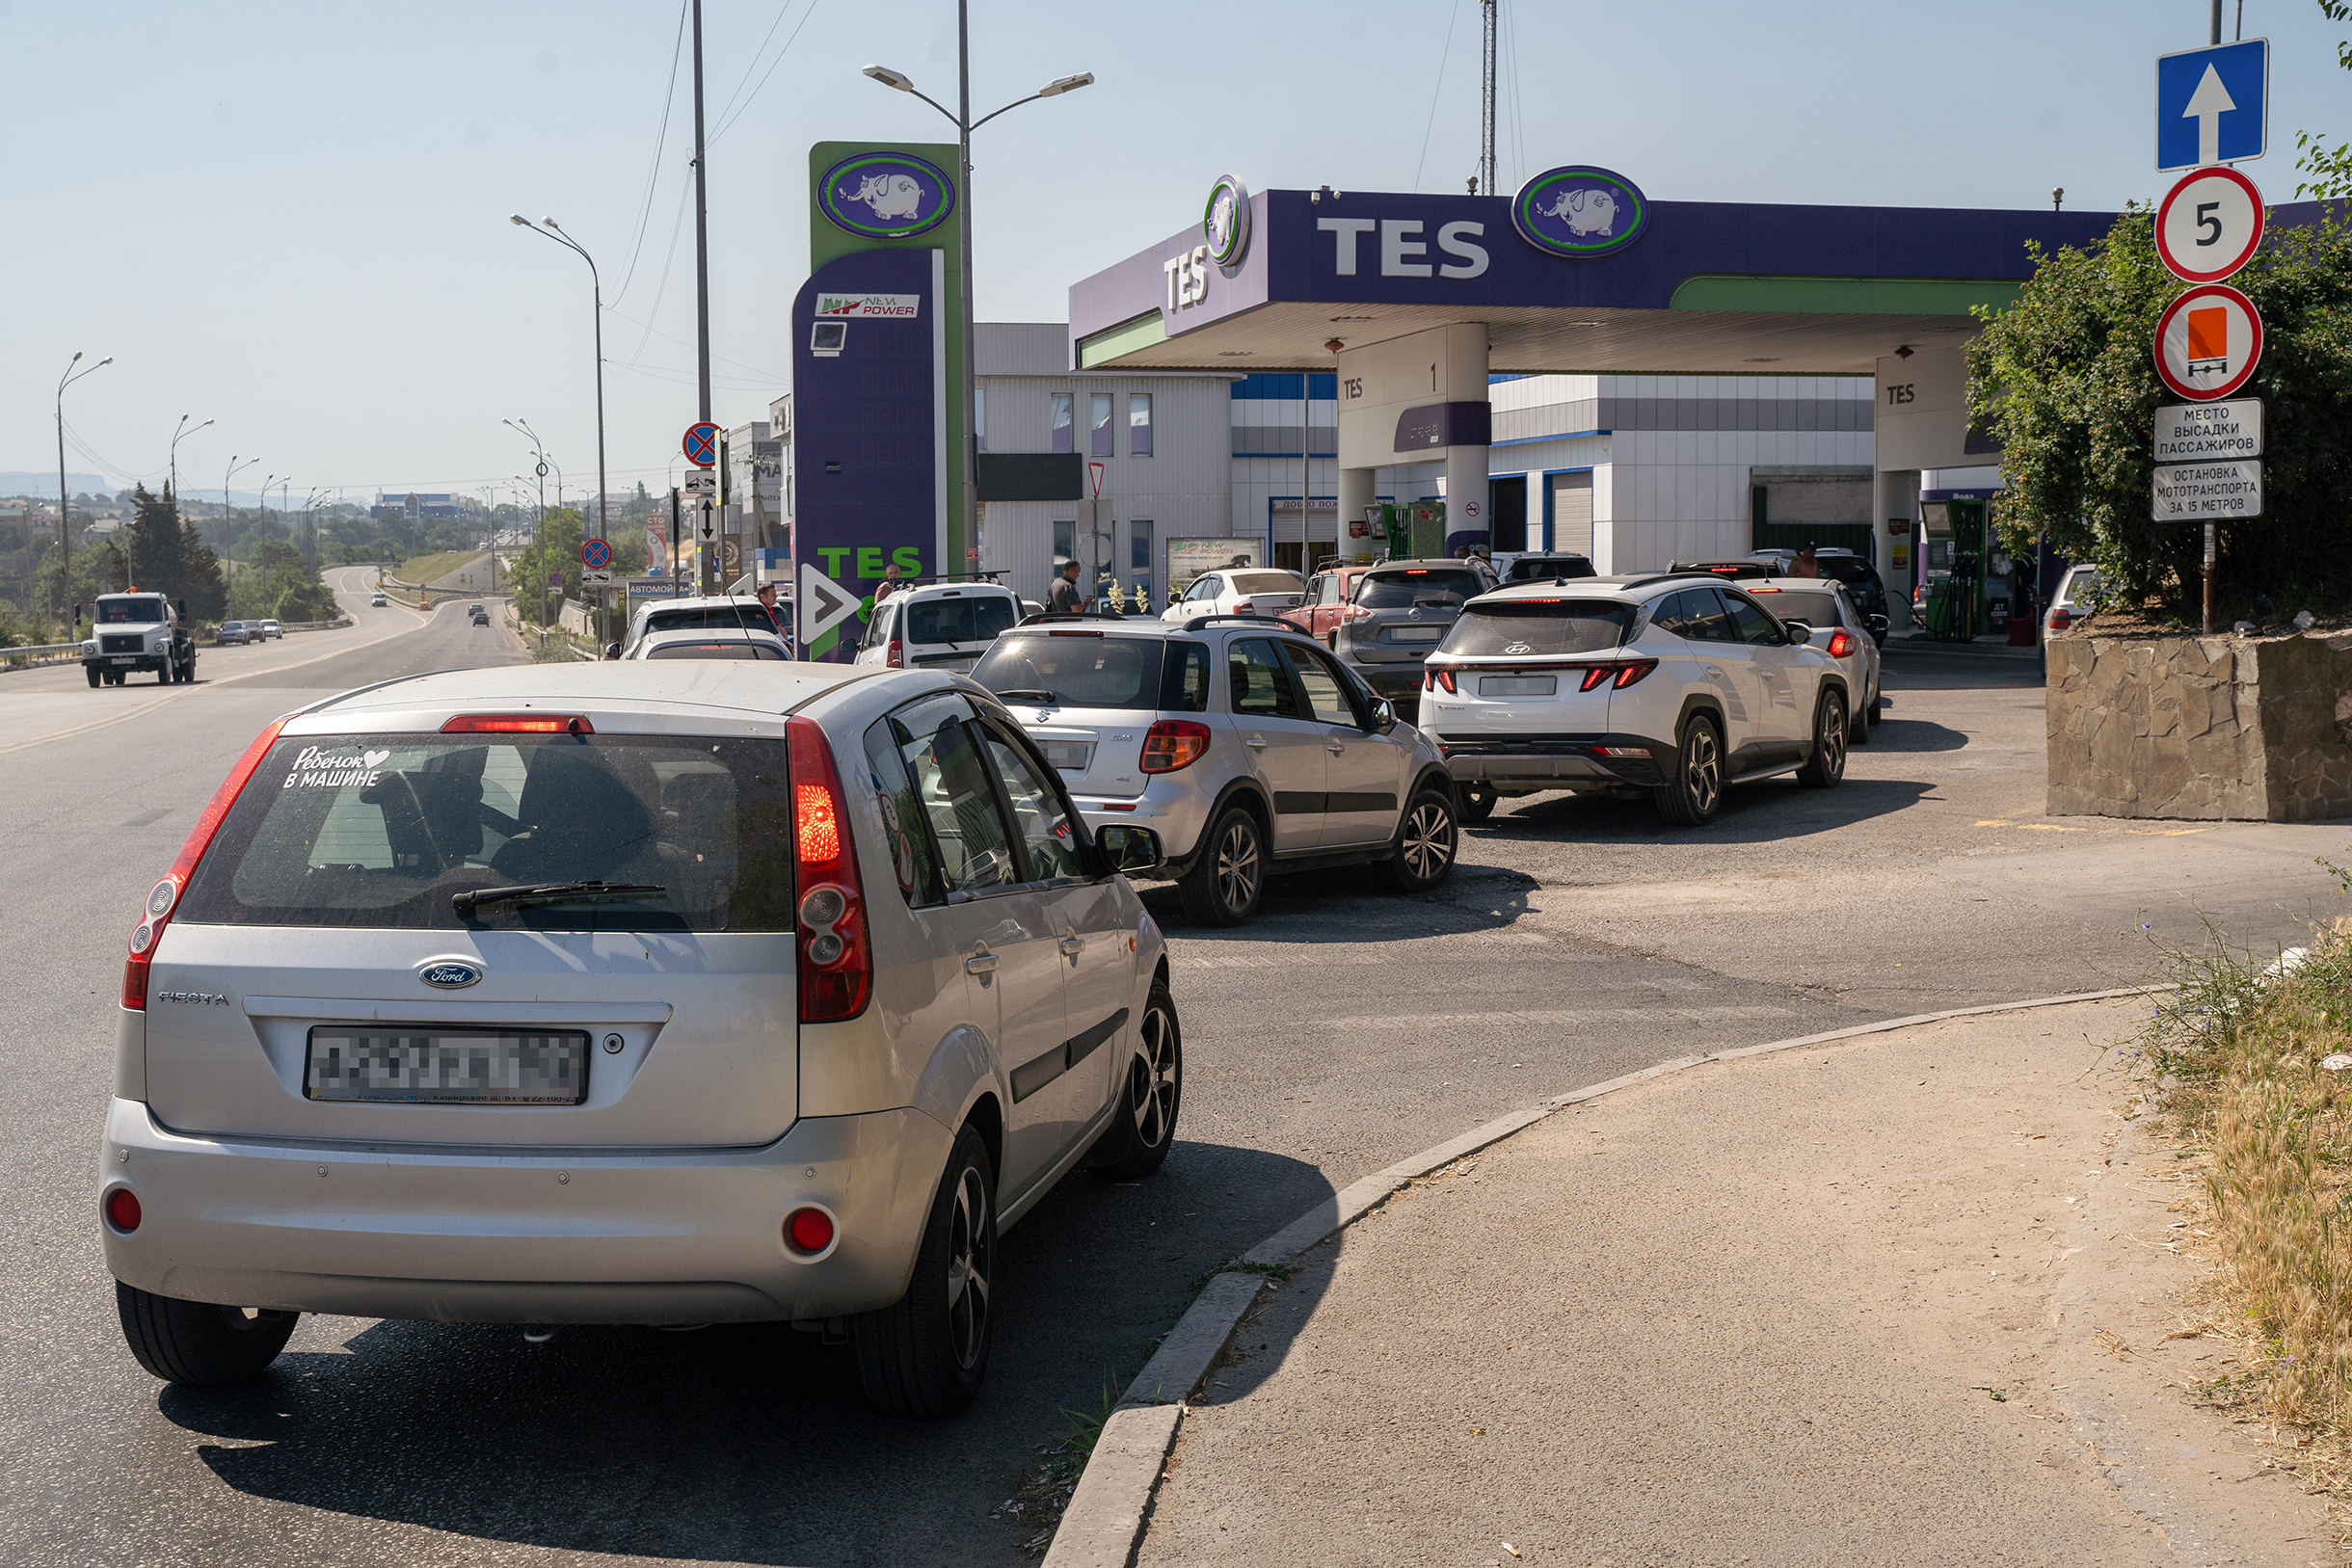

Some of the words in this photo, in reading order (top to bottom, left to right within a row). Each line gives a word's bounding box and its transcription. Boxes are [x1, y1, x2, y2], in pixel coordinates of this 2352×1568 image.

[2196, 201, 2222, 247] 5
[1317, 217, 1490, 279] TES
[1163, 245, 1208, 311] TES
[863, 306, 915, 315] POWER
[1430, 361, 1436, 392] 1
[1344, 377, 1363, 400] TES
[1886, 383, 1915, 405] TES
[2184, 407, 2230, 421] МЕСТО
[2174, 422, 2239, 439] ВЫСАДКИ
[2159, 438, 2254, 454] ПАССАЖИРОВ
[2174, 466, 2238, 482] ОСТАНОВКА
[2156, 481, 2257, 498] МОТОТРАНСПОРТА
[1282, 500, 1315, 509] ДОБО
[2169, 502, 2183, 514] ЗА
[2188, 500, 2198, 513] 15
[2201, 497, 2244, 512] МЕТРОВ
[816, 545, 922, 579] TES
[629, 583, 685, 594] АВТОМОЙА
[1993, 602, 2005, 611] ДТ
[292, 745, 364, 771] Ребенок
[282, 772, 298, 788] В
[299, 770, 382, 788] МАШИНЕ
[431, 966, 466, 983] Ford
[158, 991, 229, 1006] FIESTA
